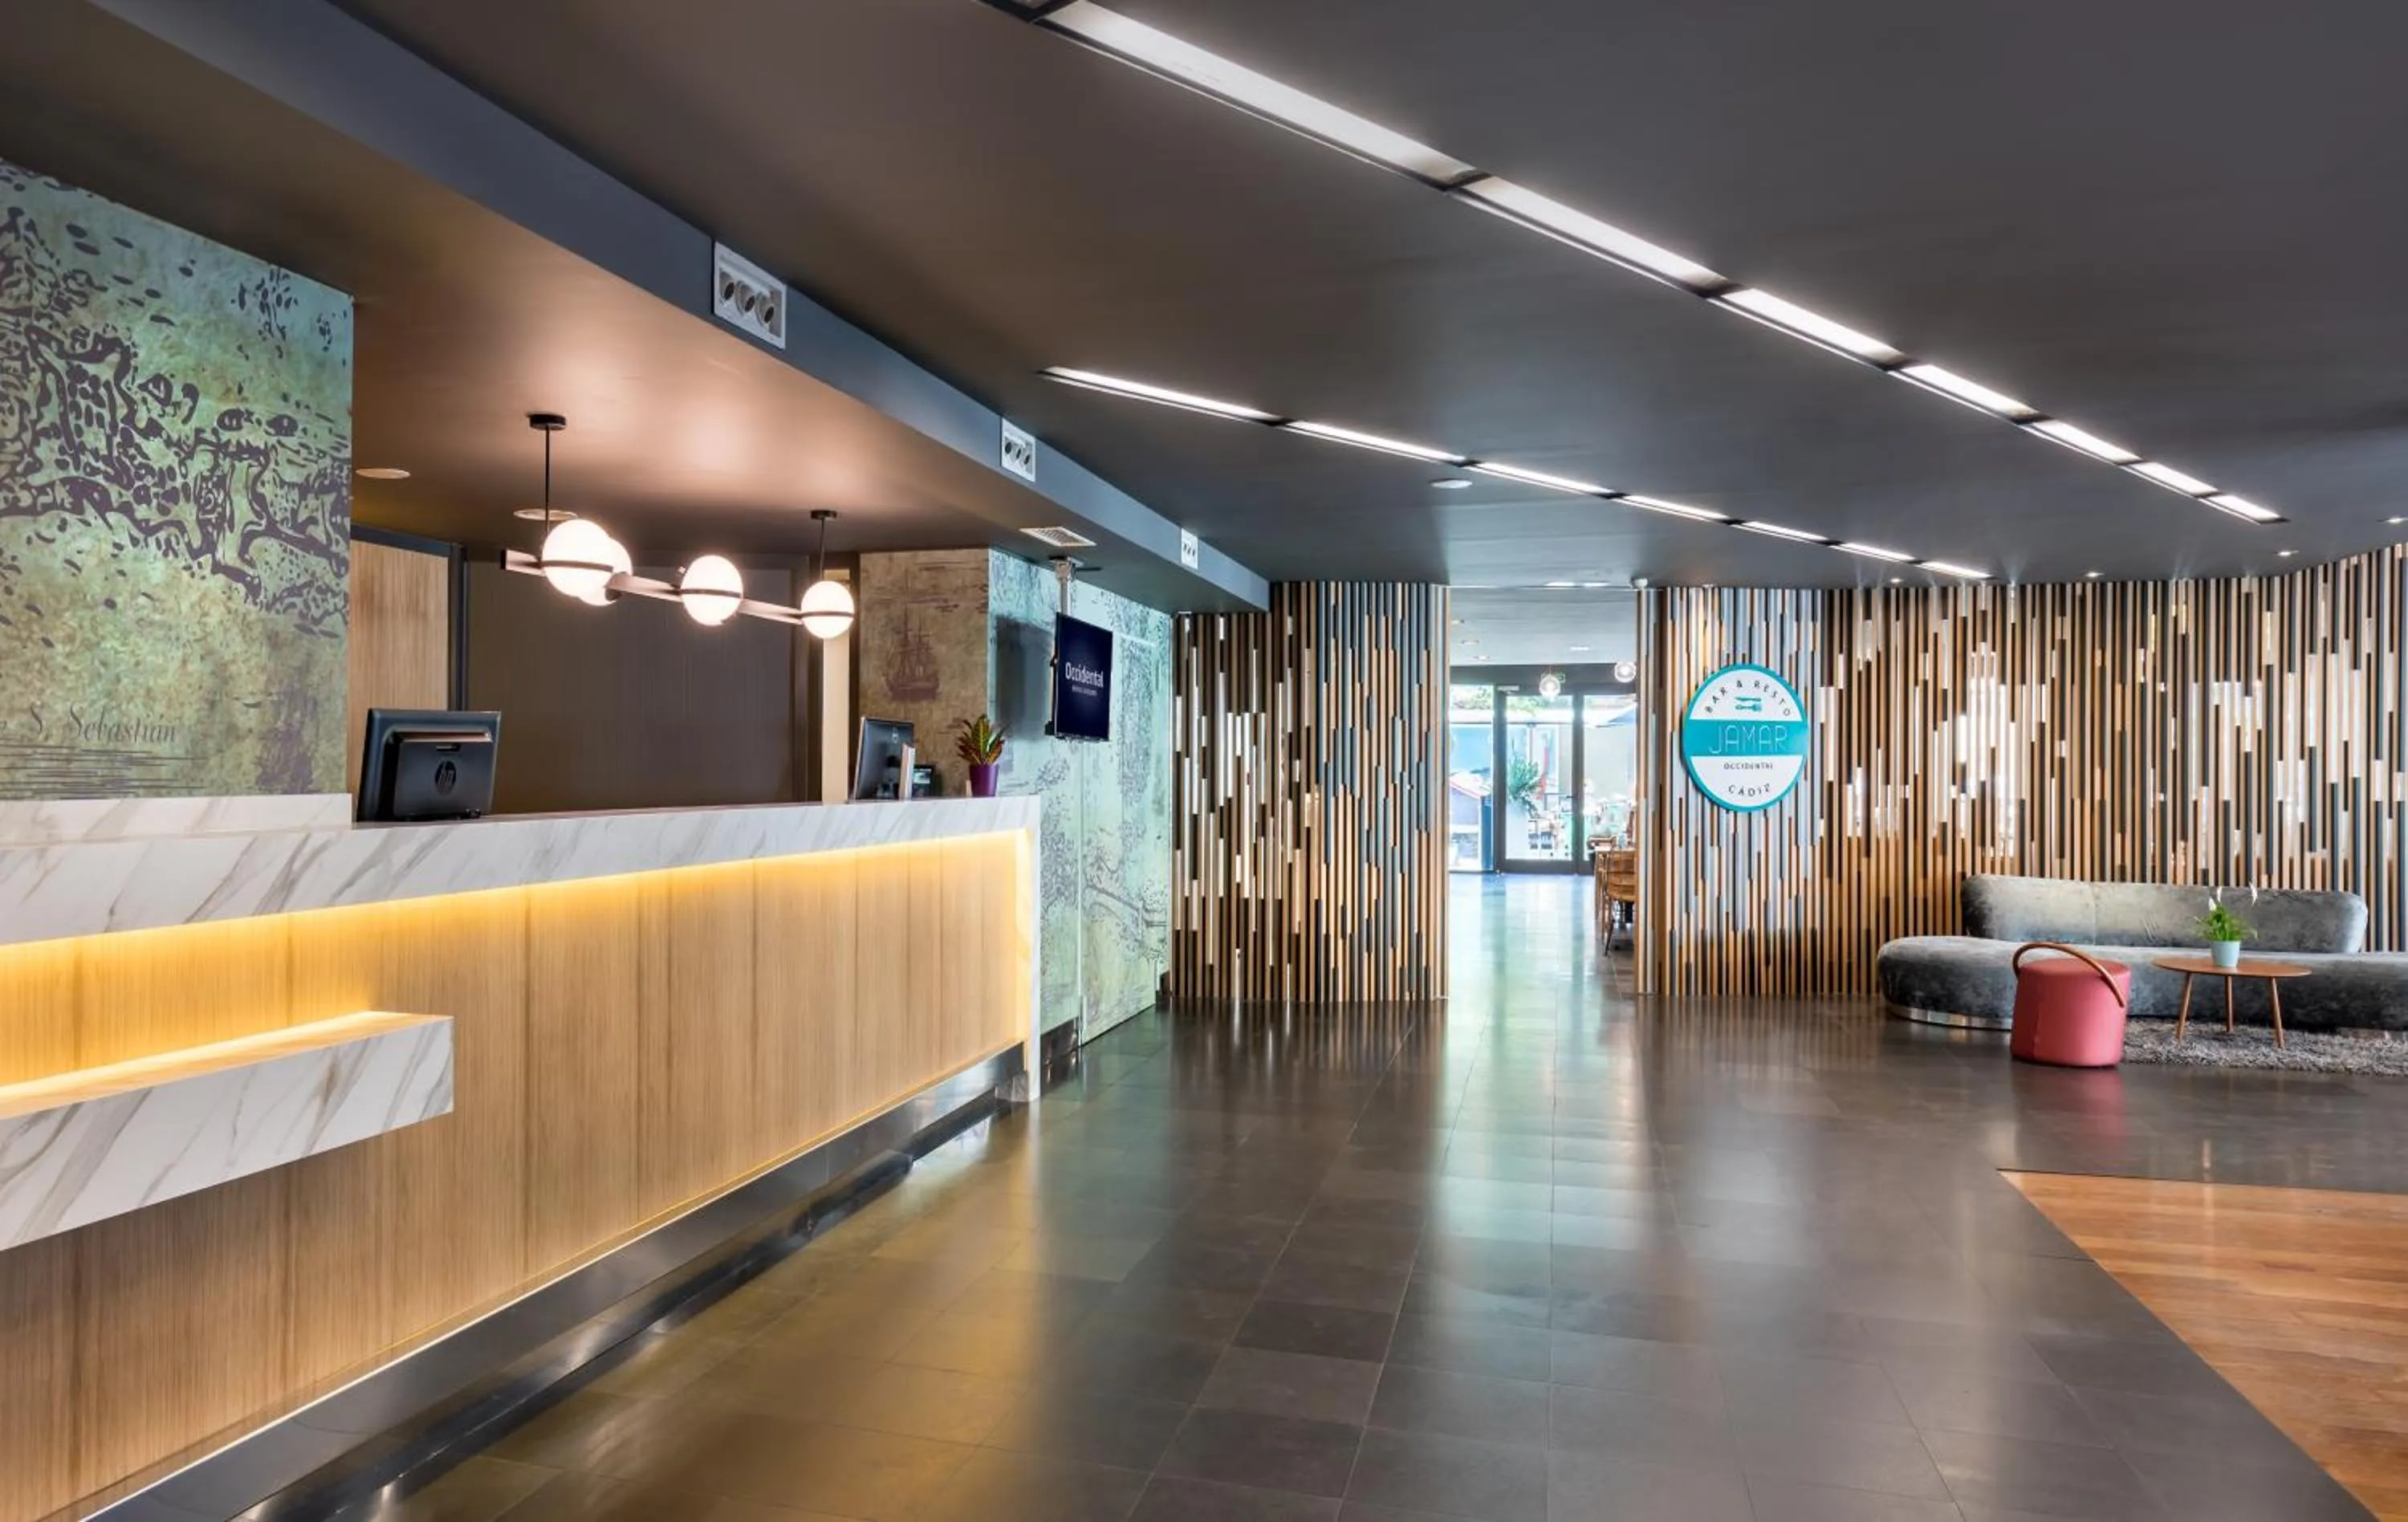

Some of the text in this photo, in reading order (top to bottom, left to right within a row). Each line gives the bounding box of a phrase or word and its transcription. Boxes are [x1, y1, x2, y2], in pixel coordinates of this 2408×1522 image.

[1065, 661, 1104, 688] Occidental
[1705, 680, 1791, 716] BAR & RESTO
[1709, 725, 1788, 754] JAMAR
